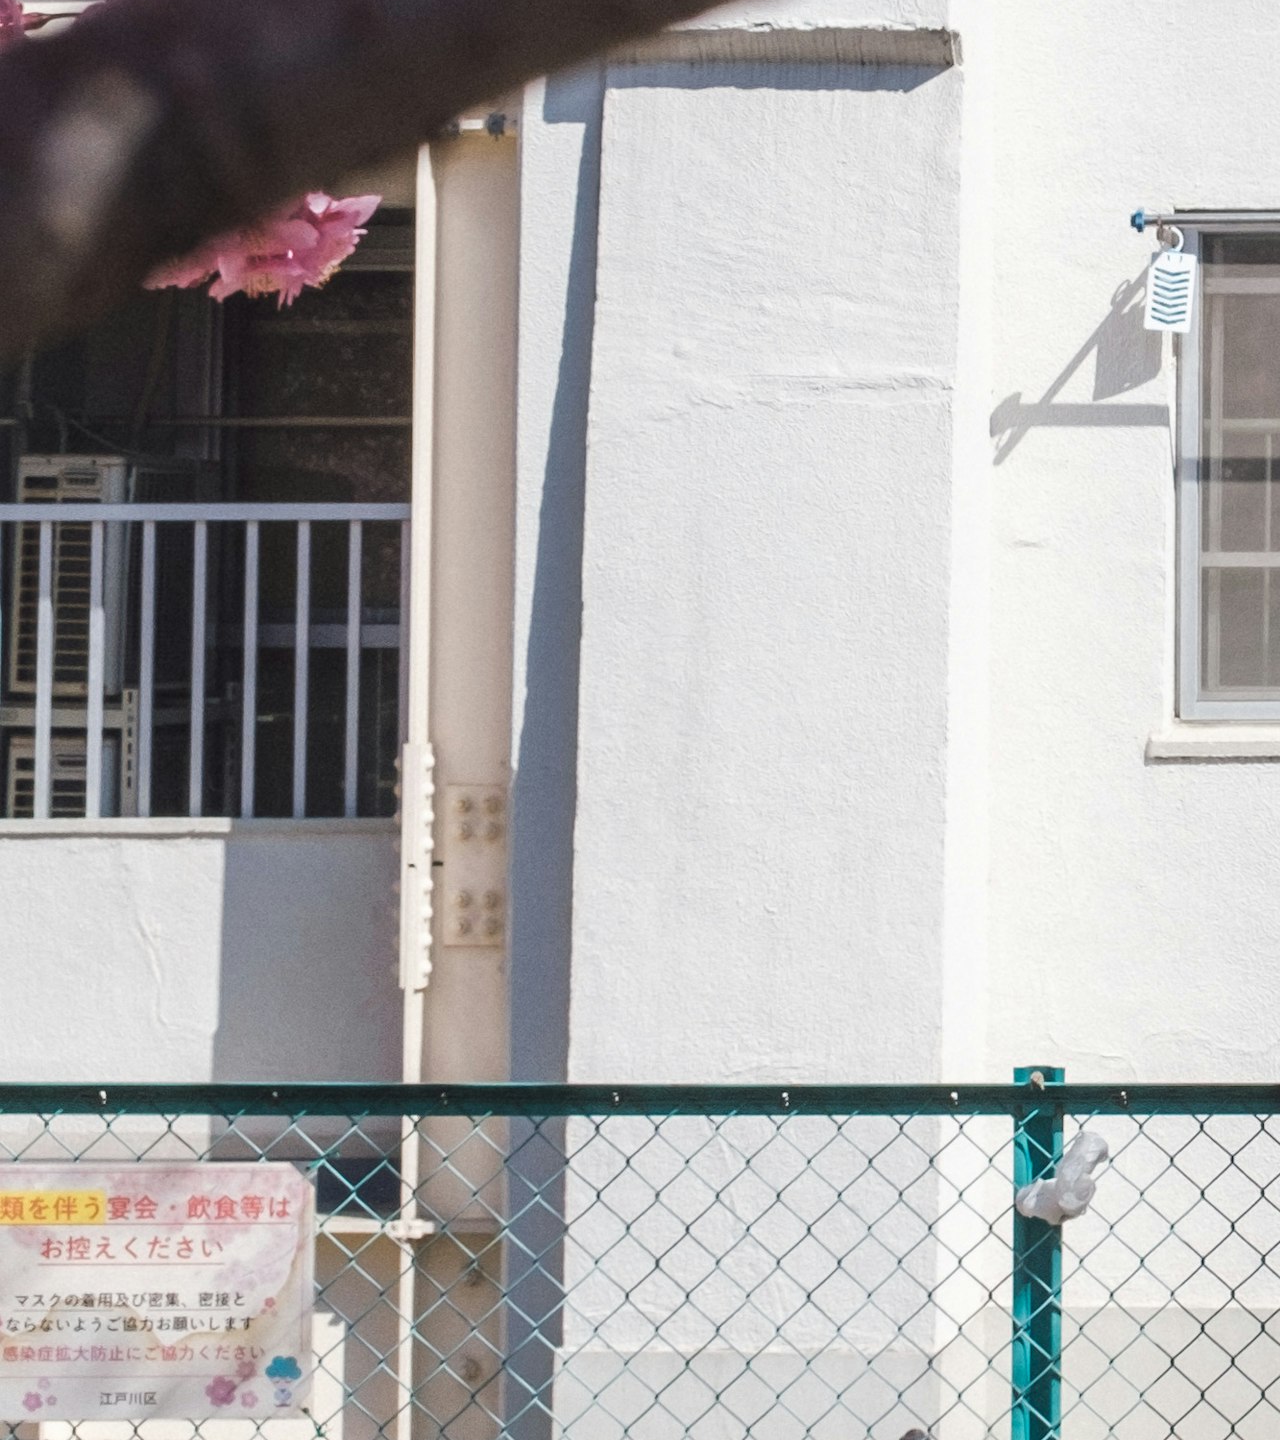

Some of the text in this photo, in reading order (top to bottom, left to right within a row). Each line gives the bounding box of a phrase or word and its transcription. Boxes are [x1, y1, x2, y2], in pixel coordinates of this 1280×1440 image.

[0, 1196, 291, 1220] 類を伴う宴会・飲食等は
[41, 1236, 223, 1260] お控えください
[15, 1292, 246, 1308] マスクの着用及び密集、密接と
[6, 1316, 254, 1332] ならないようご協力お願いします
[2, 1346, 265, 1361] 感染症拡大防止にご協力ください
[100, 1391, 157, 1406] 江戸川区
